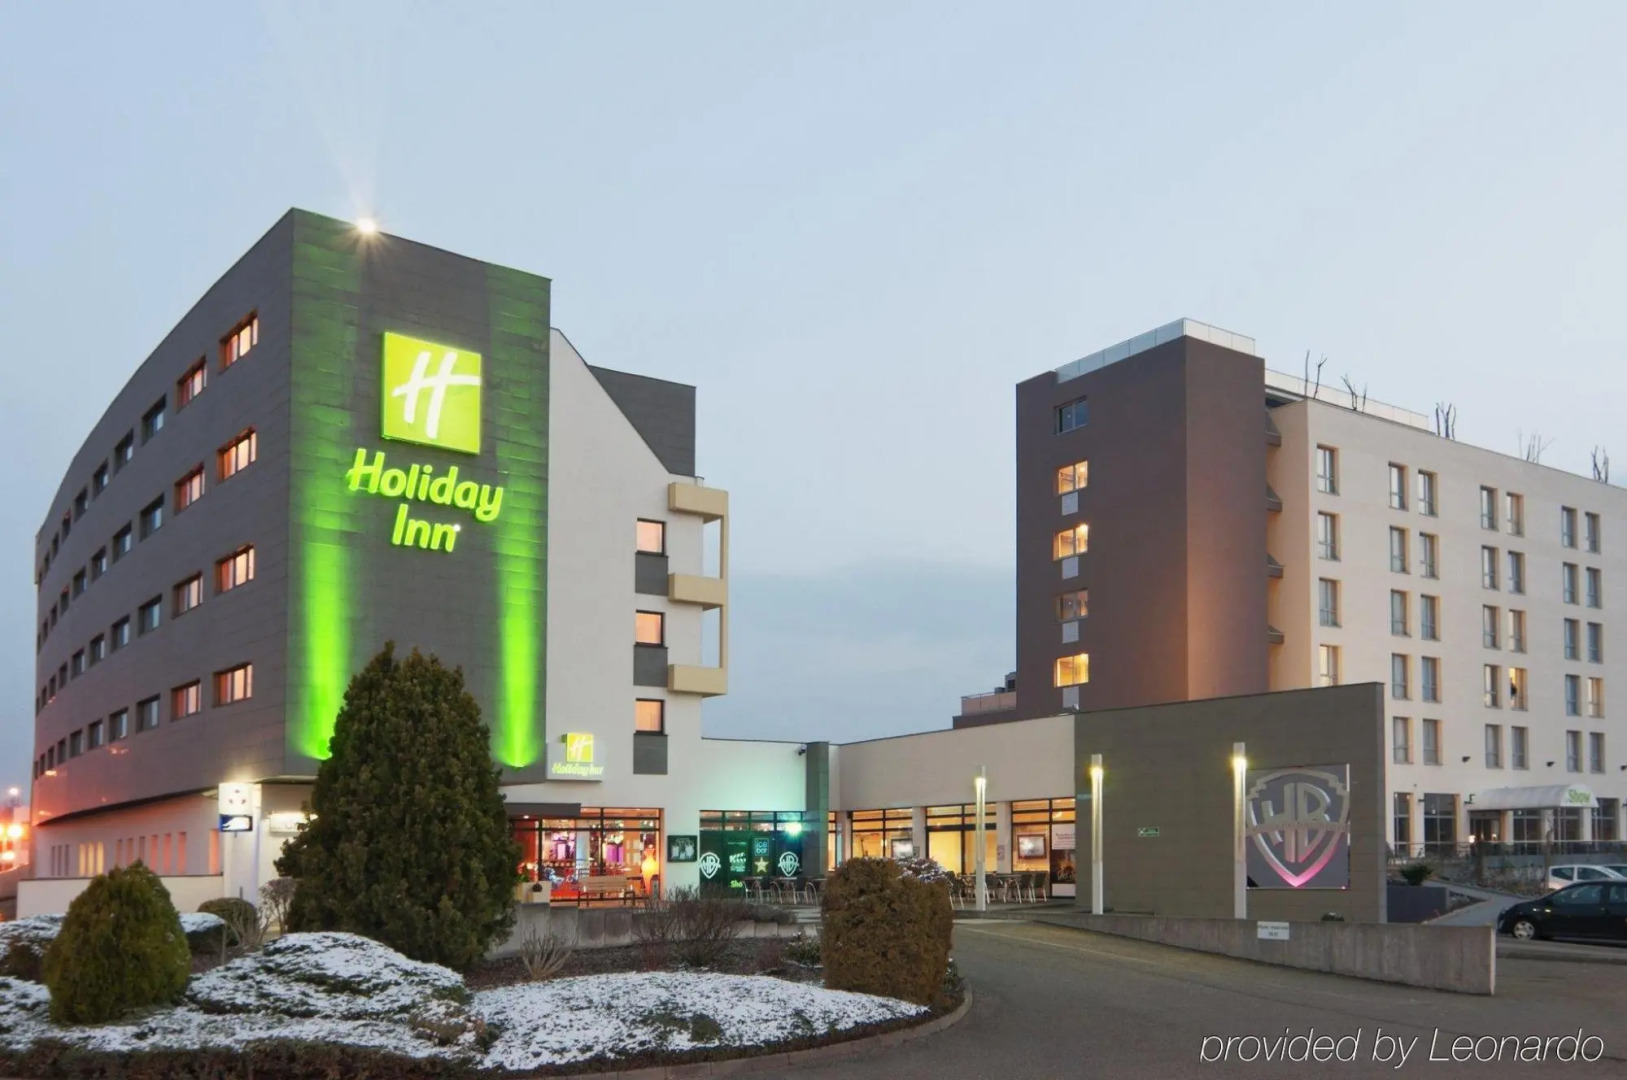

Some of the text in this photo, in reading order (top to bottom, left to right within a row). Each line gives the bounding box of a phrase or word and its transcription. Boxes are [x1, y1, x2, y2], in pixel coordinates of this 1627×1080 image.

[346, 447, 504, 522] Holiday
[391, 503, 459, 553] Inn
[552, 762, 588, 777] Holiday
[730, 879, 743, 889] Sho
